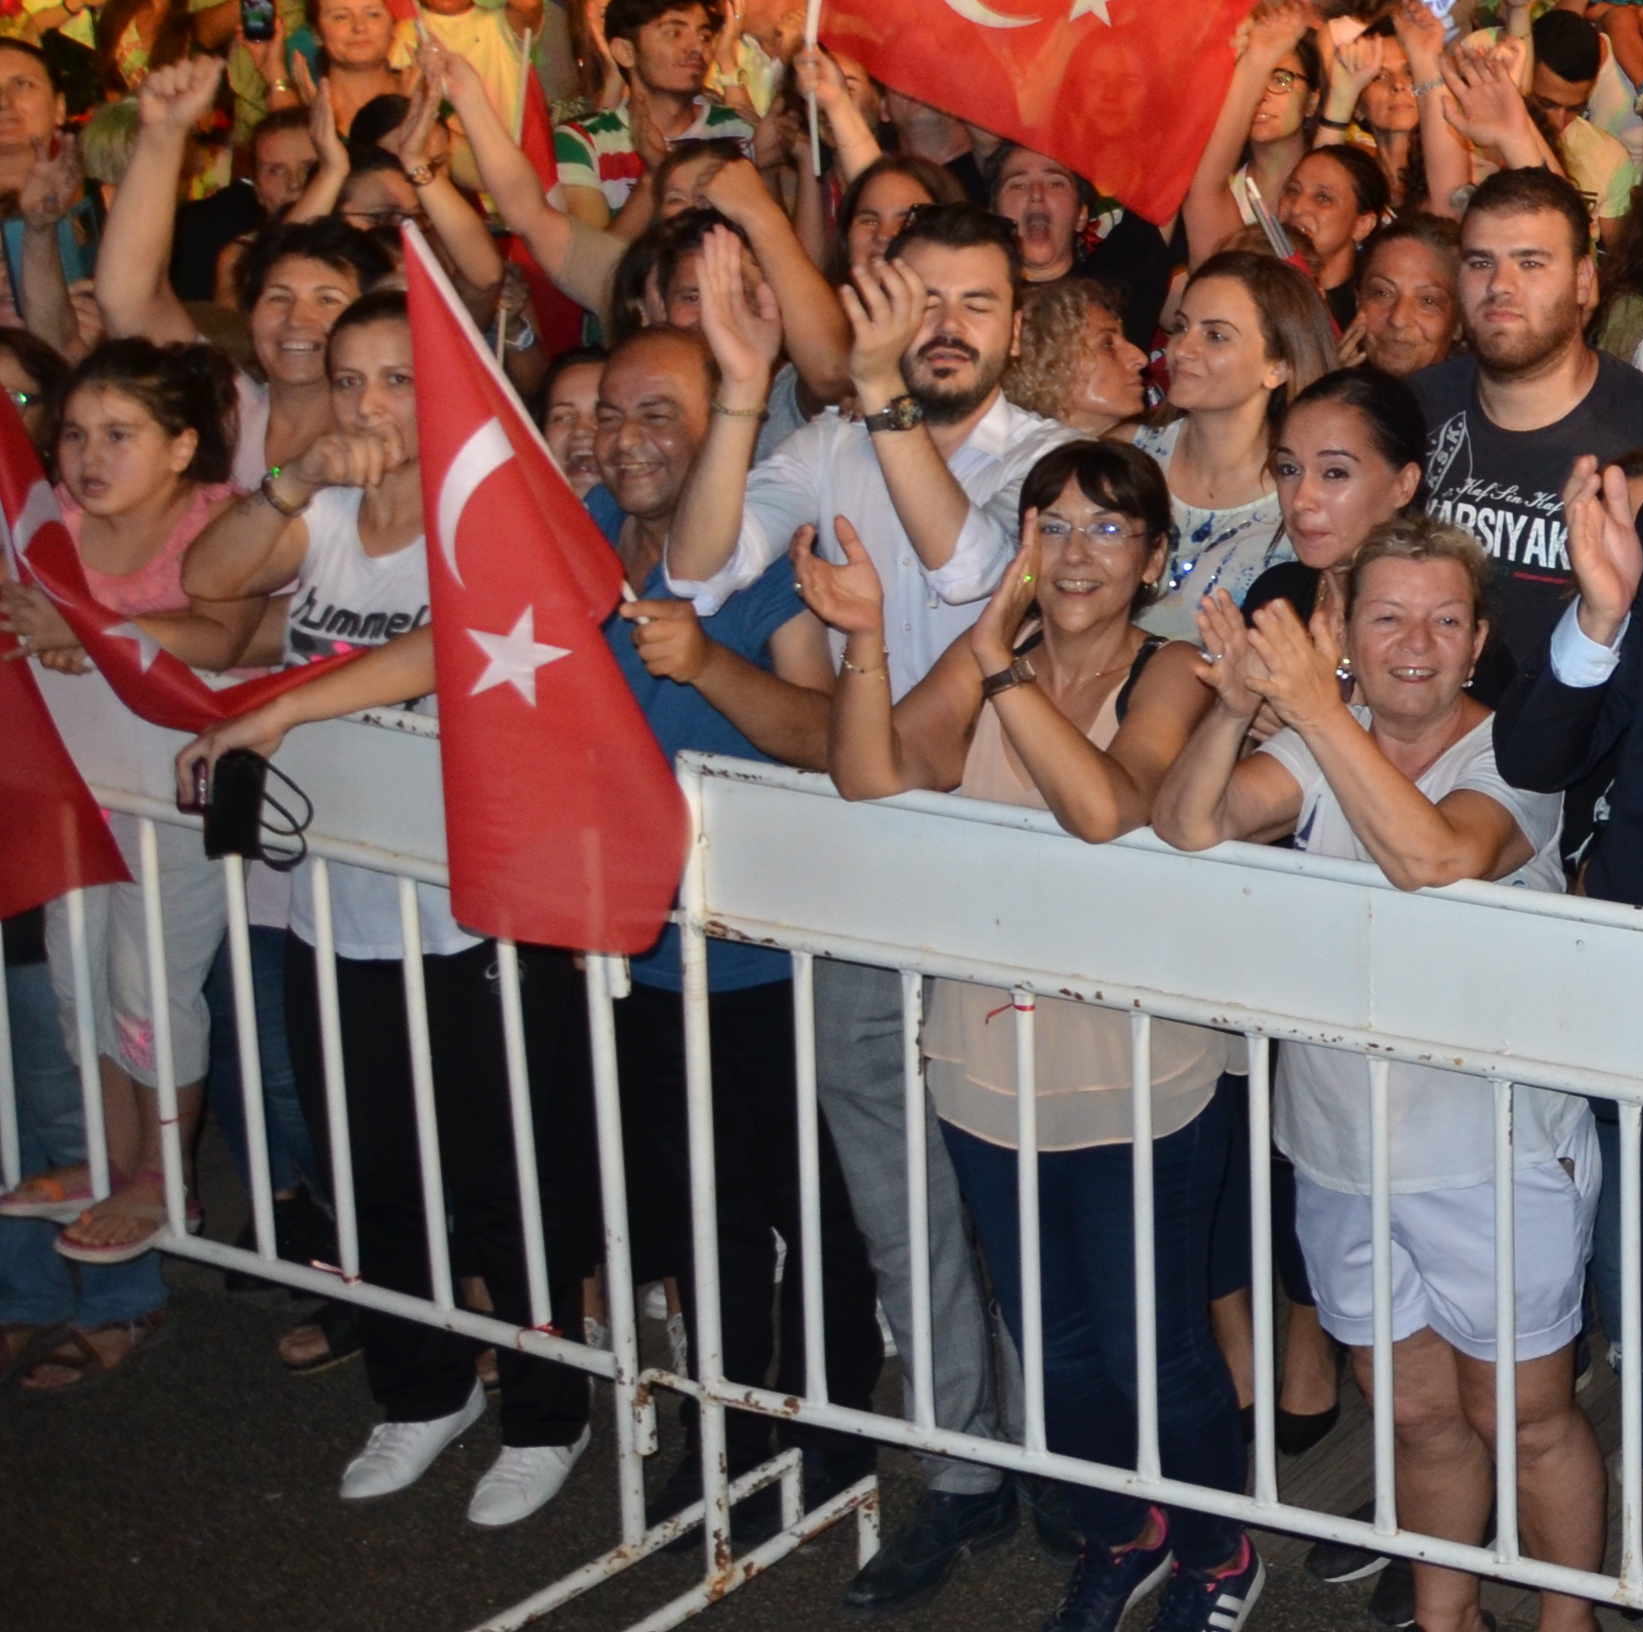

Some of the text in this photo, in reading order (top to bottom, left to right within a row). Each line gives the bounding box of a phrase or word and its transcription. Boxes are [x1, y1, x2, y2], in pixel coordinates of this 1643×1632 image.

[1456, 477, 1495, 503] Kaf
[1524, 491, 1565, 517] Kaf
[290, 586, 430, 639] hummel
